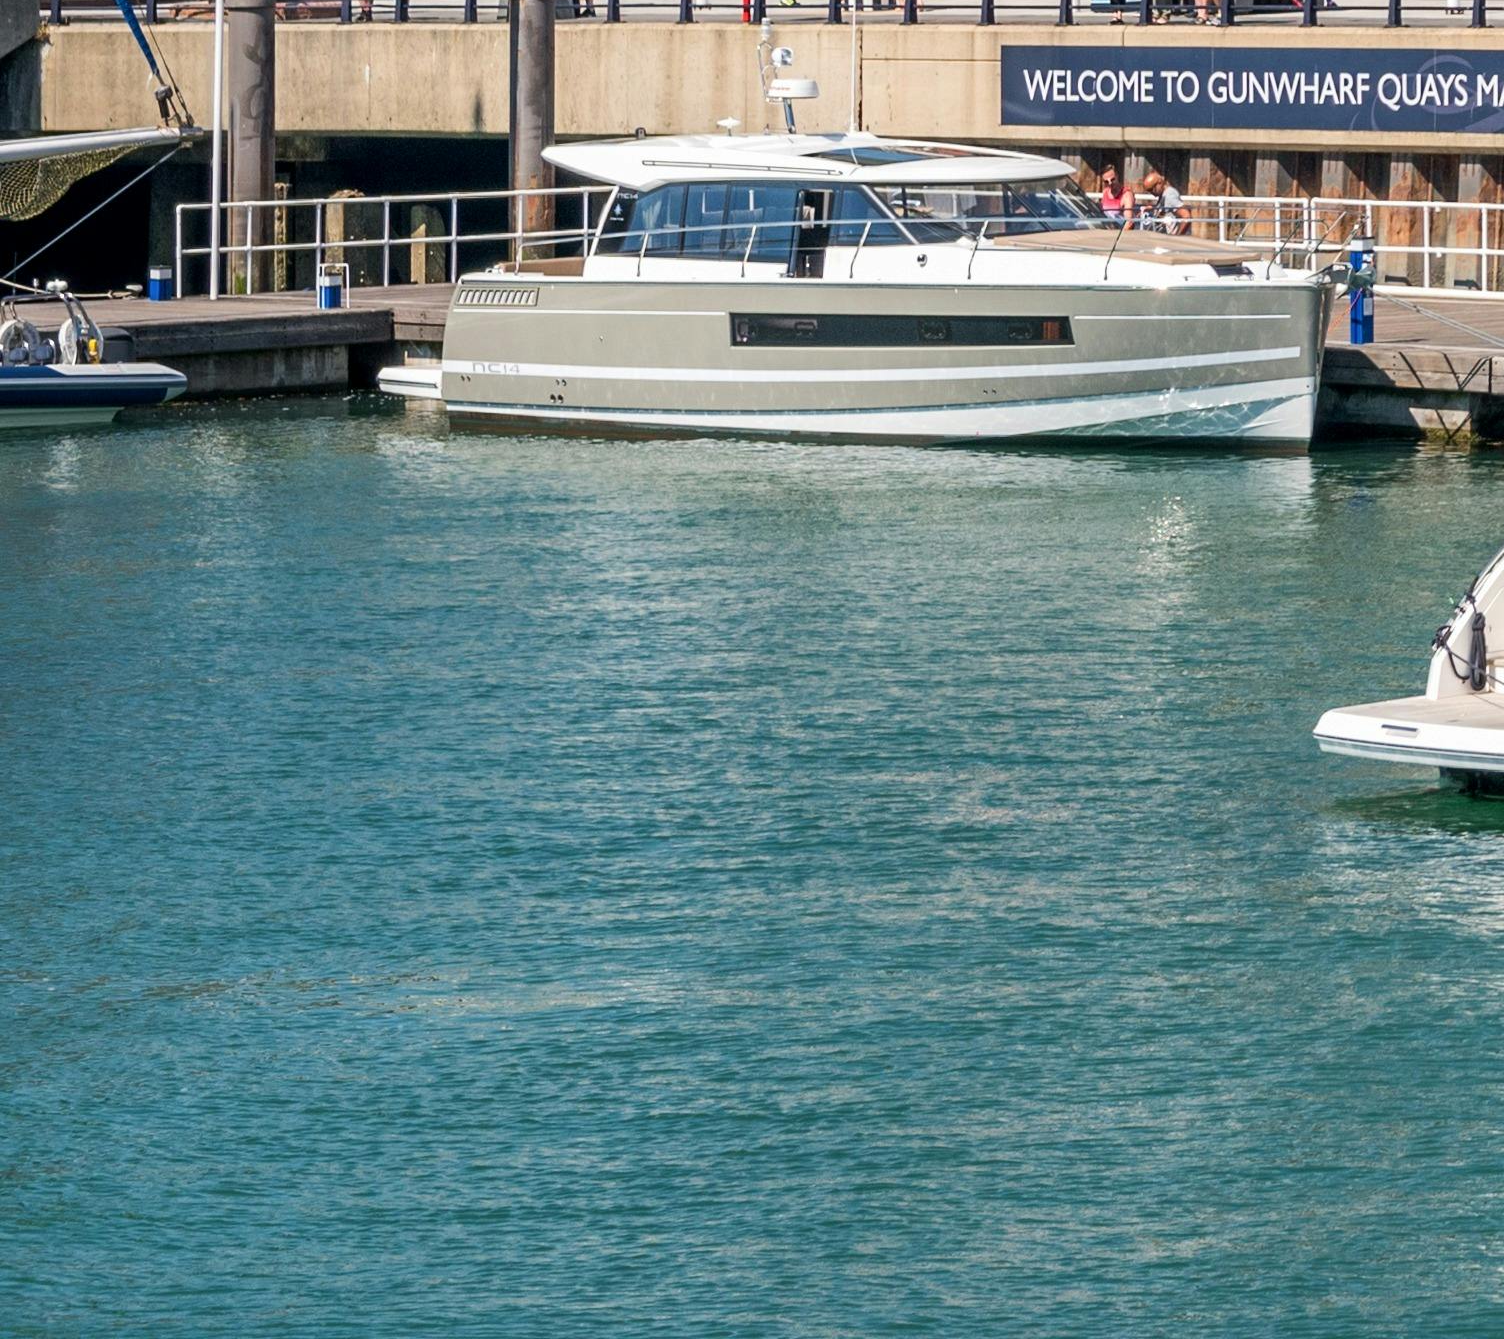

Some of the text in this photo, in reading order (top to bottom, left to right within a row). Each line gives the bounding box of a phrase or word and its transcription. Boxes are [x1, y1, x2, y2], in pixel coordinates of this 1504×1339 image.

[1023, 69, 1154, 104] WELCOME
[1160, 70, 1200, 104] TO
[1207, 71, 1369, 106] GUNWHARF
[1378, 73, 1468, 111] QUAYS
